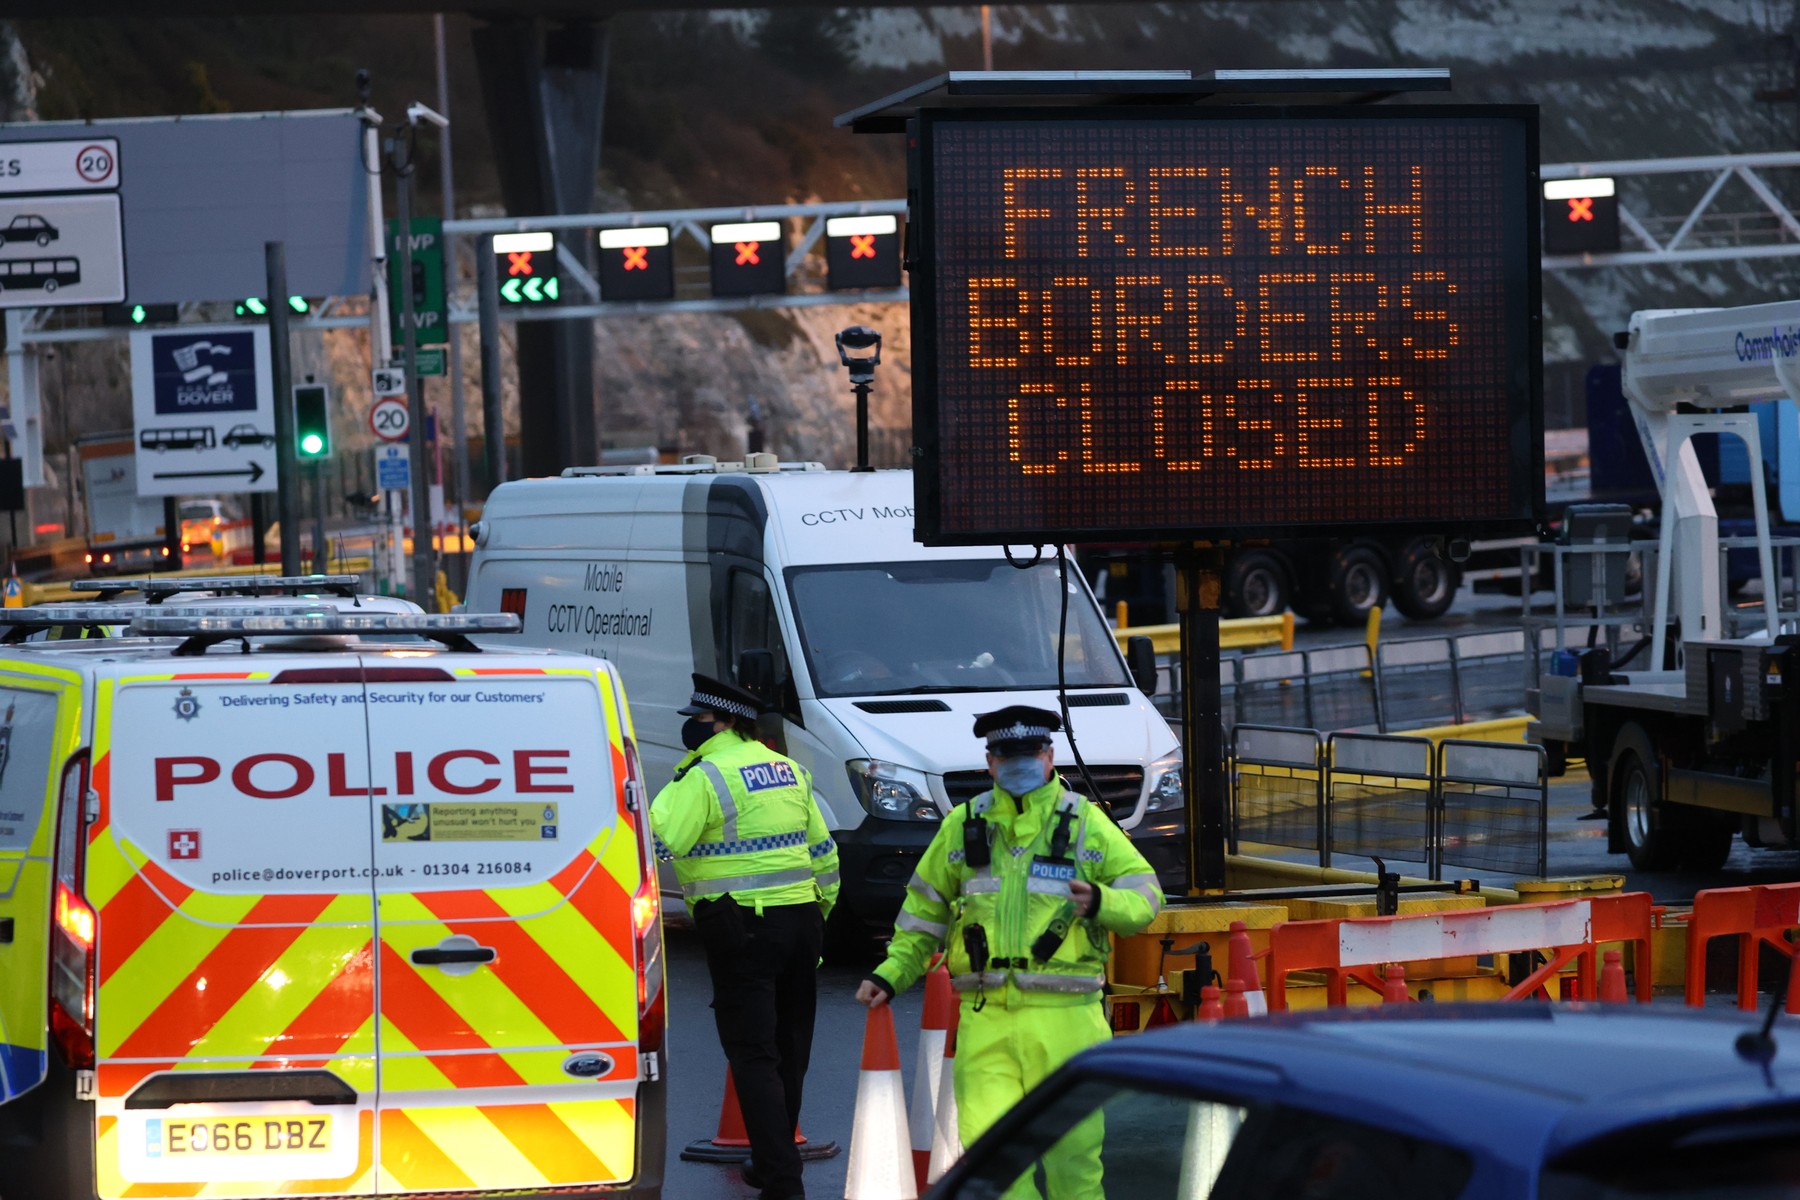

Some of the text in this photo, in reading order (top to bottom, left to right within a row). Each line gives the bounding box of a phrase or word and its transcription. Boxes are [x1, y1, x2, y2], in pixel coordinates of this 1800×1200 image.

[83, 156, 108, 172] 20
[1004, 165, 1422, 258] FRENCH
[969, 271, 1459, 368] BORDERS
[178, 390, 233, 405] DOVER
[376, 409, 405, 430] 20
[1008, 377, 1426, 475] CLOSED
[801, 508, 864, 526] CCTV
[584, 563, 623, 592] Mobile
[548, 604, 653, 641] CCTV Operational
[293, 693, 337, 706] Safety
[341, 692, 366, 703] and
[369, 692, 425, 705] Security
[428, 691, 447, 702] for
[450, 693, 471, 702] our
[154, 749, 575, 801] POLICE
[743, 764, 796, 788] POLICE
[432, 807, 518, 817] Reporting anything
[471, 818, 495, 826] won't
[498, 818, 517, 826] hurt
[519, 819, 536, 827] you
[212, 865, 403, 884] police@doverport.co.uk
[423, 864, 470, 876] 01304
[477, 862, 532, 875] 216084
[1032, 863, 1074, 881] POLICE
[264, 1120, 326, 1150] DBZ
